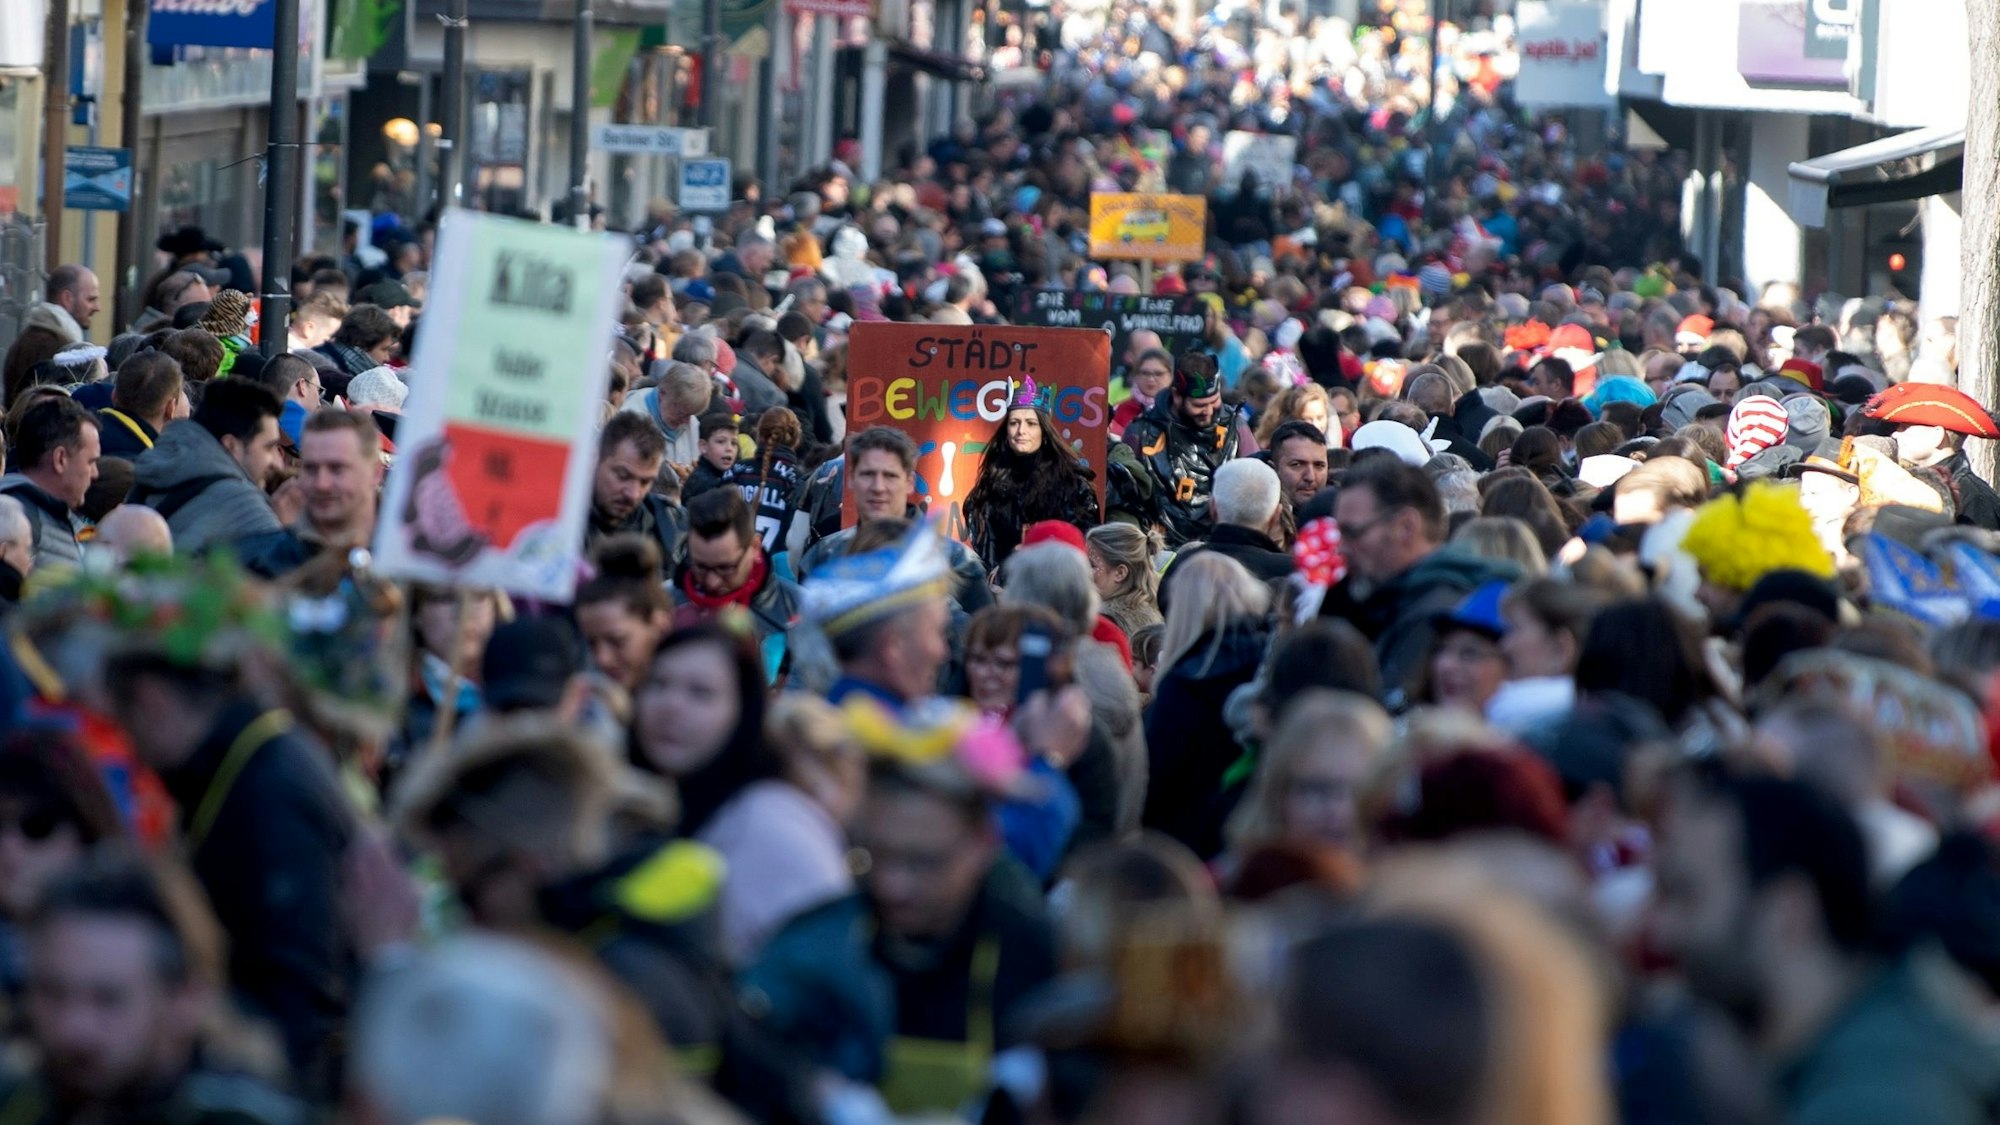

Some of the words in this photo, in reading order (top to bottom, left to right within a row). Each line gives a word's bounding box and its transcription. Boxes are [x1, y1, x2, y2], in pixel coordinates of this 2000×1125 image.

[1047, 309, 1081, 325] VOM
[908, 330, 1038, 373] STÄDT.
[852, 376, 1106, 428] BEWEGGS
